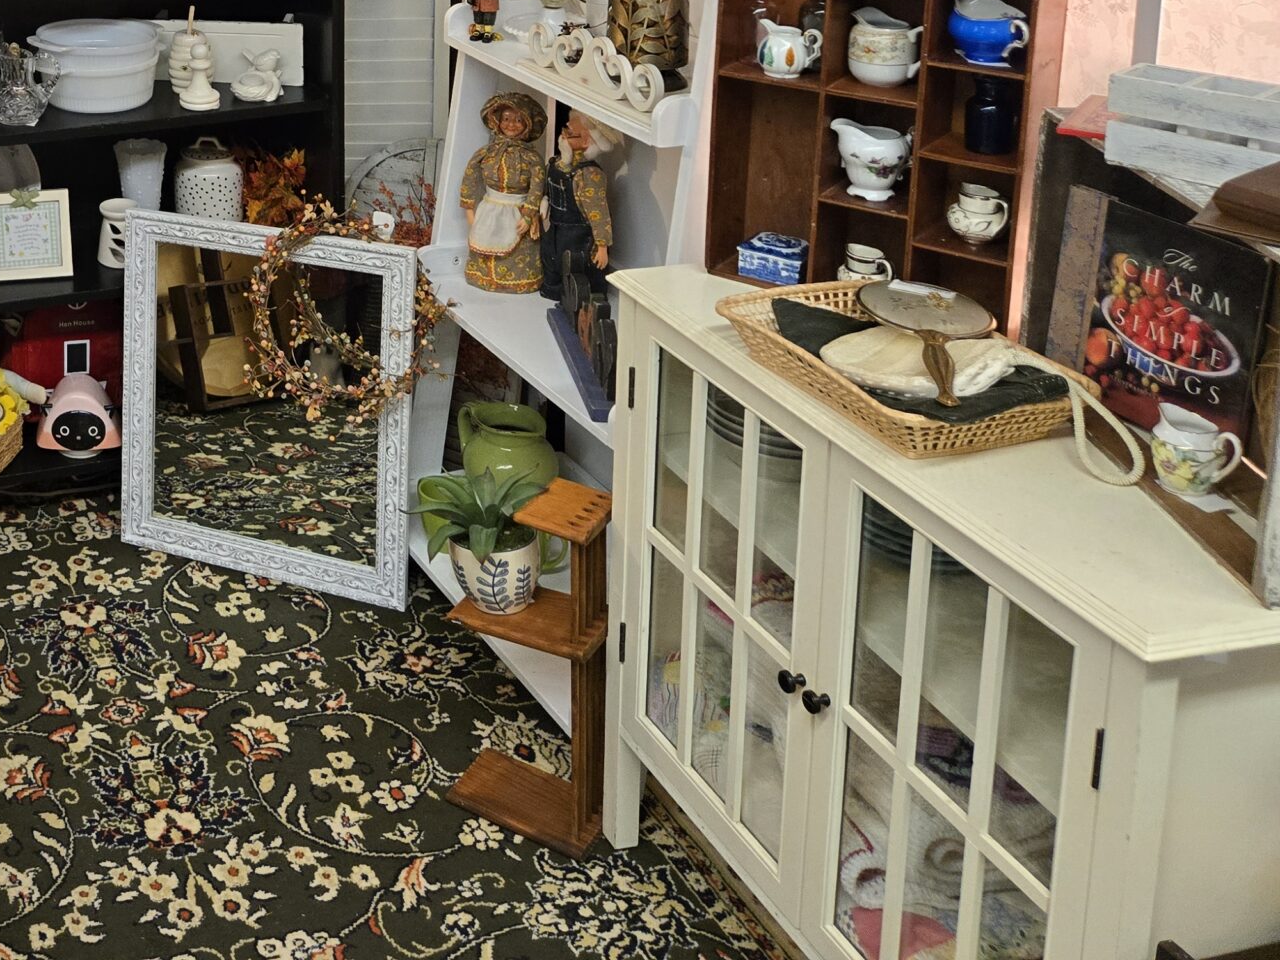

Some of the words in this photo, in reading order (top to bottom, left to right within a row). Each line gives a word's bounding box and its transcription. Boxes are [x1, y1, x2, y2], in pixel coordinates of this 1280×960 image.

[1123, 258, 1231, 316] CHARM
[1163, 248, 1199, 272] The
[1115, 308, 1224, 369] SIMPLE
[1108, 338, 1221, 405] THINGS
